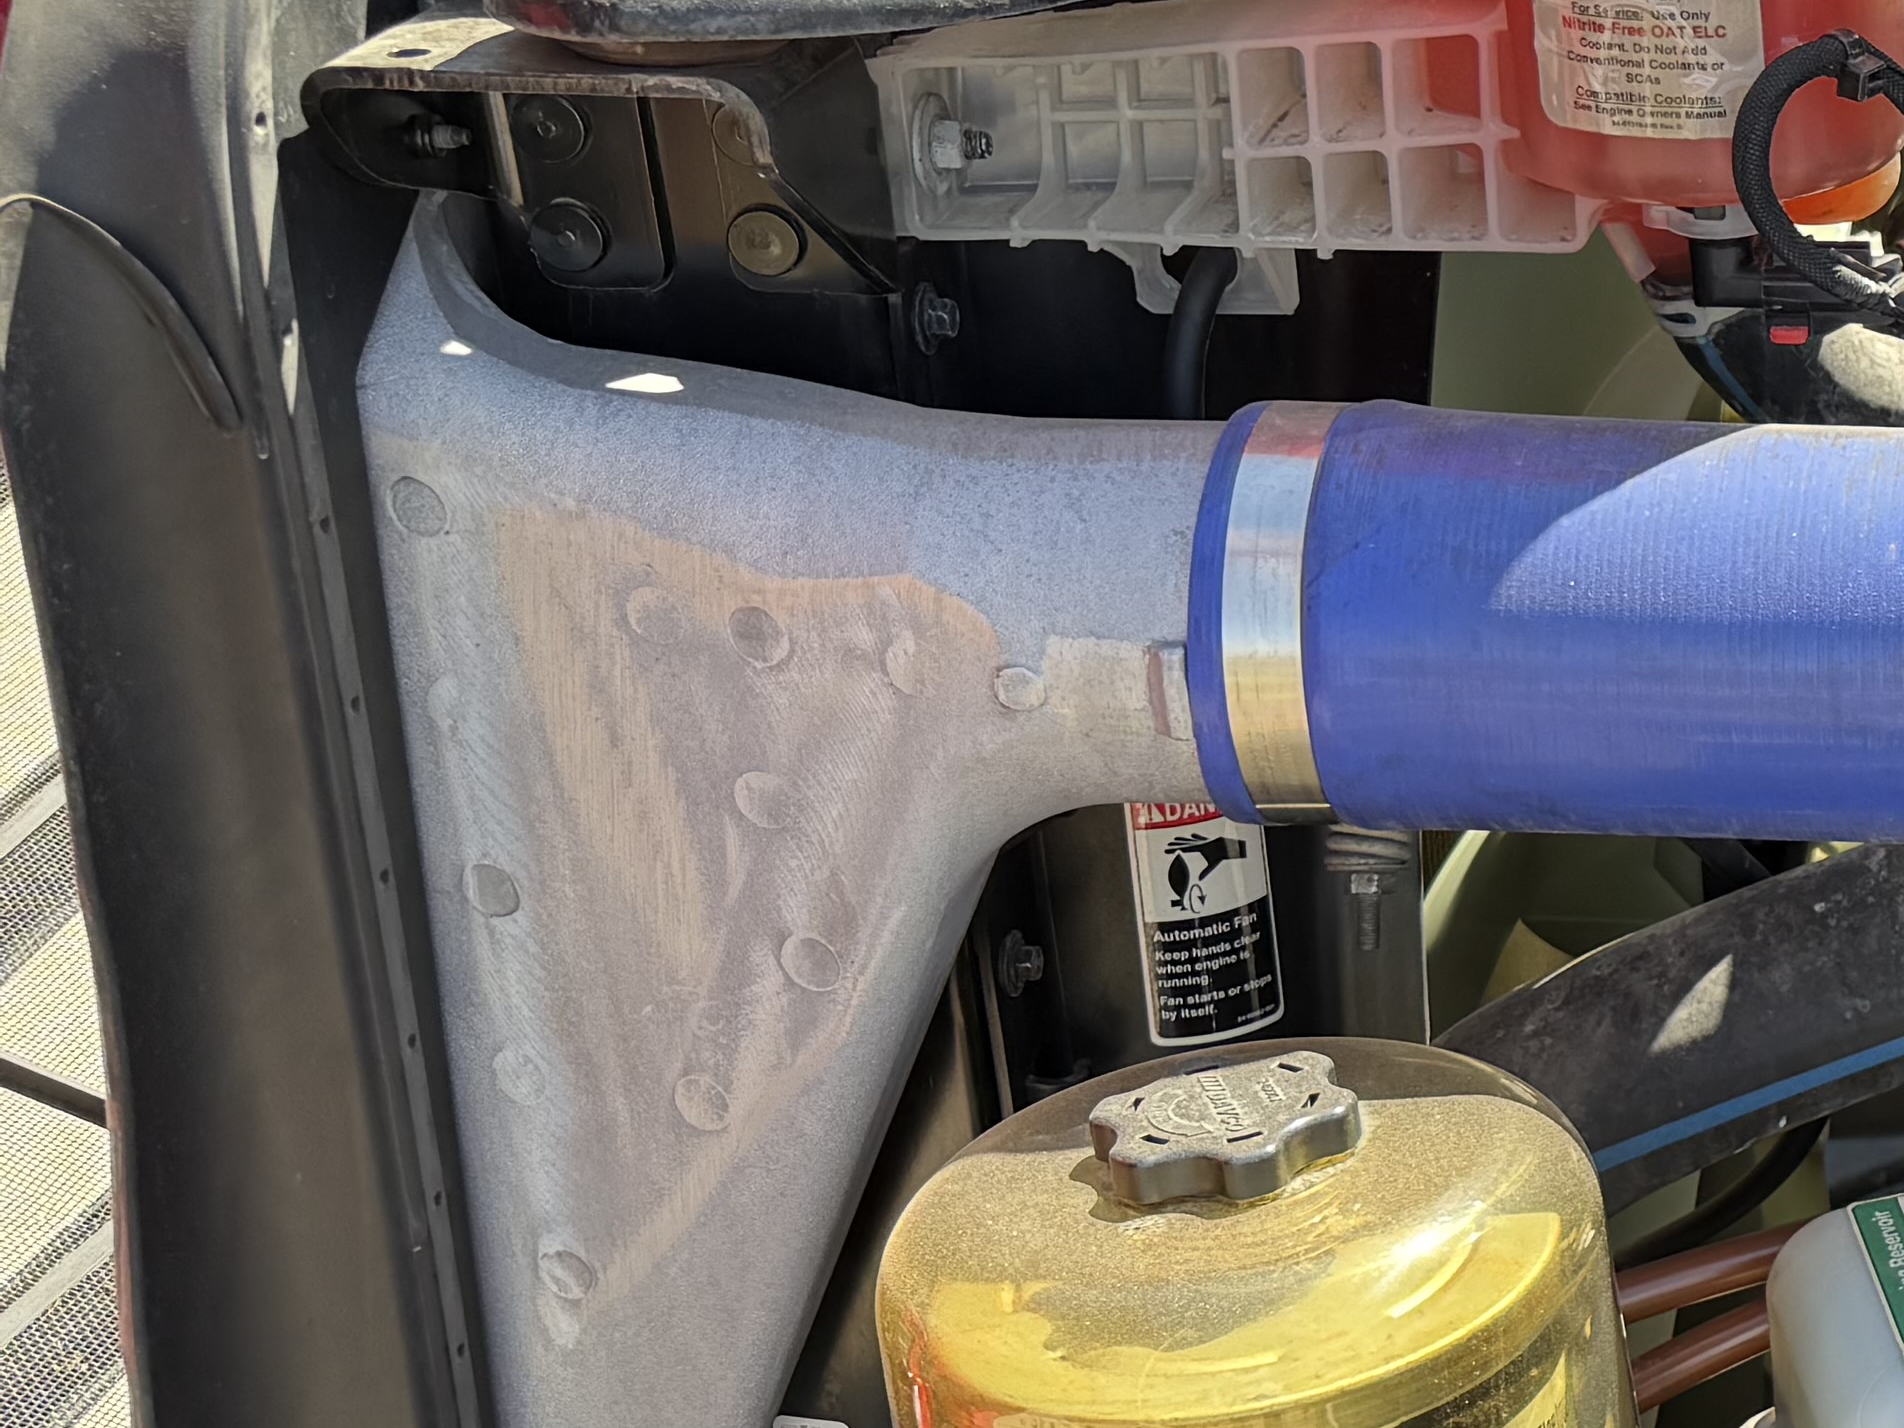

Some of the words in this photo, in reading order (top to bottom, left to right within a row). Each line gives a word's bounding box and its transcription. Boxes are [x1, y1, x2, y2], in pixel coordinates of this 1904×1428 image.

[1571, 1, 1591, 15] For
[1680, 10, 1711, 24] Only
[1651, 24, 1688, 40] OAT
[1692, 24, 1728, 40] ELC
[1633, 42, 1650, 54] Do
[1654, 43, 1678, 55] Not
[1681, 44, 1707, 56] Add
[1567, 51, 1645, 69] Conventional
[1649, 59, 1708, 71] Coolants
[1711, 61, 1724, 71] or
[1626, 73, 1661, 85] SCAs
[1576, 85, 1649, 104] Compatible
[1574, 100, 1593, 113] See
[1595, 103, 1634, 119] Engine
[1684, 108, 1727, 120] Manual
[1153, 922, 1231, 943] Automatic
[1234, 912, 1257, 930] Fan
[1155, 947, 1190, 962] Keep
[1192, 940, 1231, 959] hands
[1233, 930, 1261, 948] clear
[1156, 962, 1191, 975] when
[1195, 954, 1238, 974] engine
[1239, 950, 1251, 962] is
[1158, 974, 1213, 989] running.
[1159, 994, 1184, 1006] Fan
[1187, 987, 1226, 1005] starts
[1228, 983, 1241, 995] or
[1244, 973, 1273, 992] stops
[1161, 1007, 1178, 1022] by
[1180, 1005, 1218, 1020] itself.
